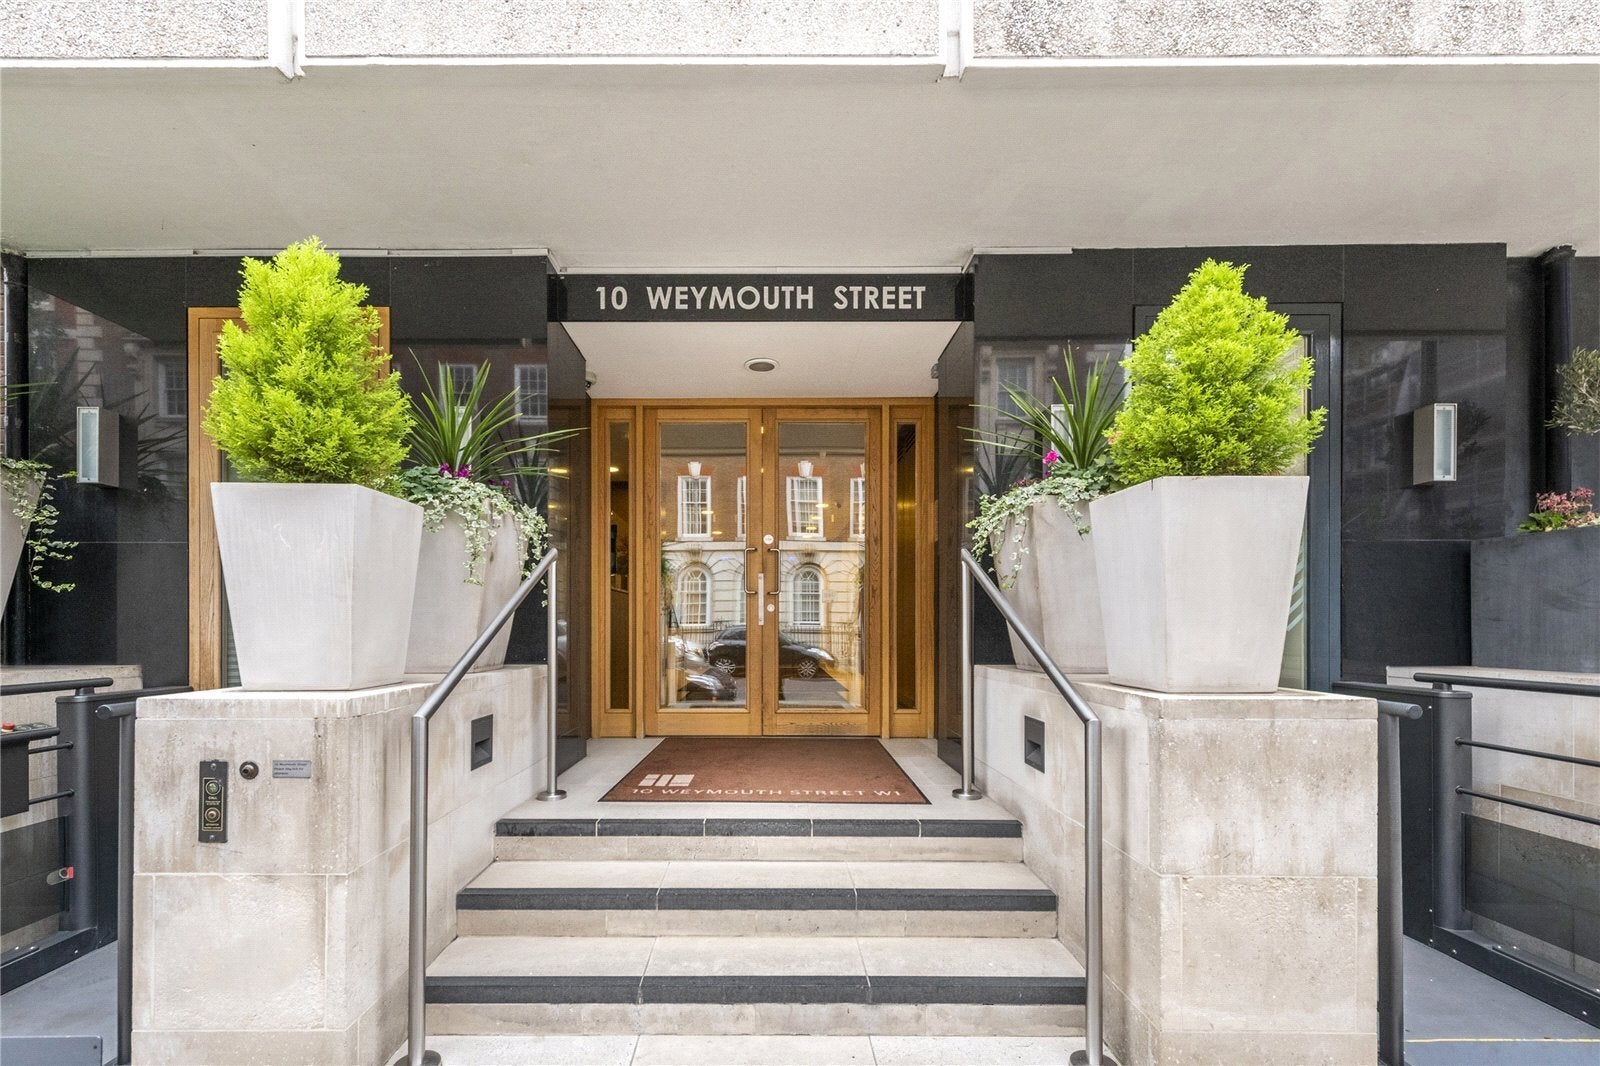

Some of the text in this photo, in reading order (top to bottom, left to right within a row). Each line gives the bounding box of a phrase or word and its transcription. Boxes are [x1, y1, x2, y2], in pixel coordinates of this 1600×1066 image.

[595, 285, 926, 310] 10 WEYMOUTH STREET
[873, 789, 901, 797] W1
